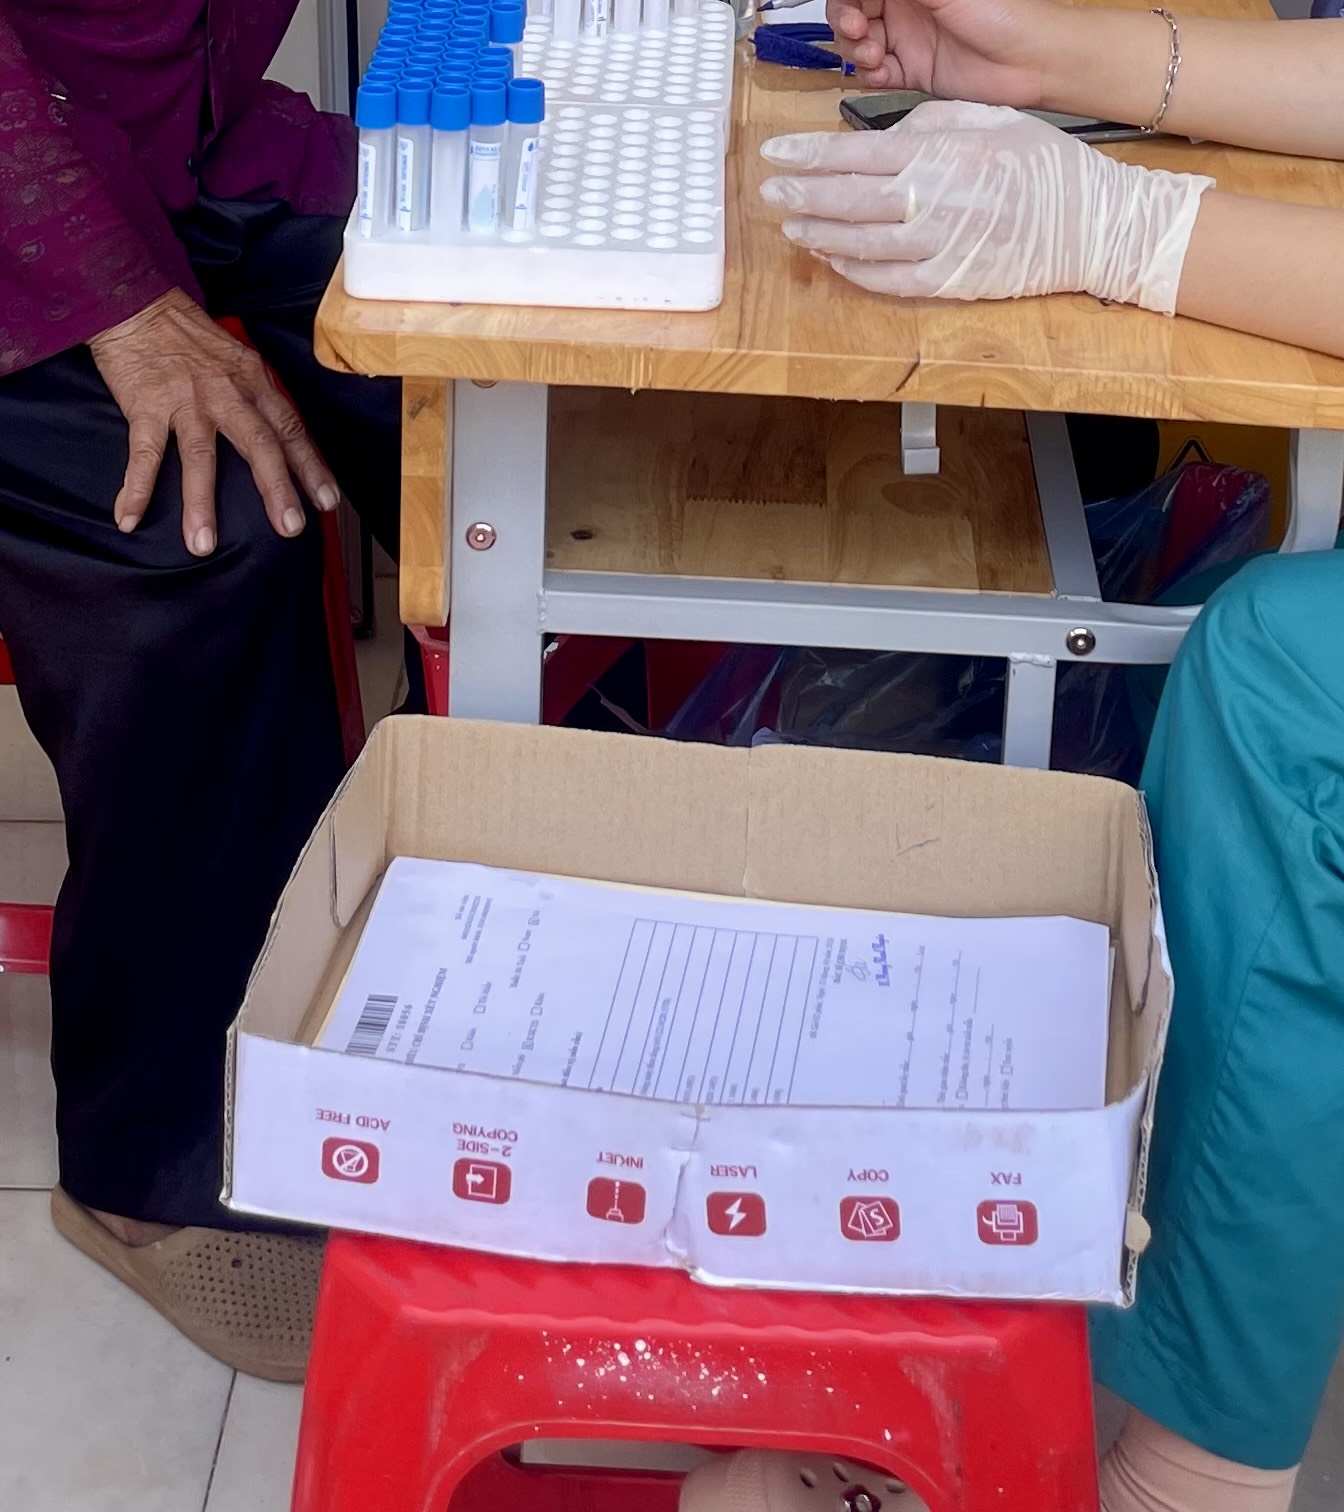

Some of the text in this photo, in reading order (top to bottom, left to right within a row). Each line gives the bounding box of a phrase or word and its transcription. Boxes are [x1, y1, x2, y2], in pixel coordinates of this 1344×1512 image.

[315, 1108, 391, 1131] ACID FREE
[452, 1121, 519, 1143] COPYING
[596, 1151, 644, 1169] INKJET
[710, 1164, 757, 1178] LASER
[847, 1167, 889, 1182] COPY
[991, 1171, 1022, 1186] FAX
